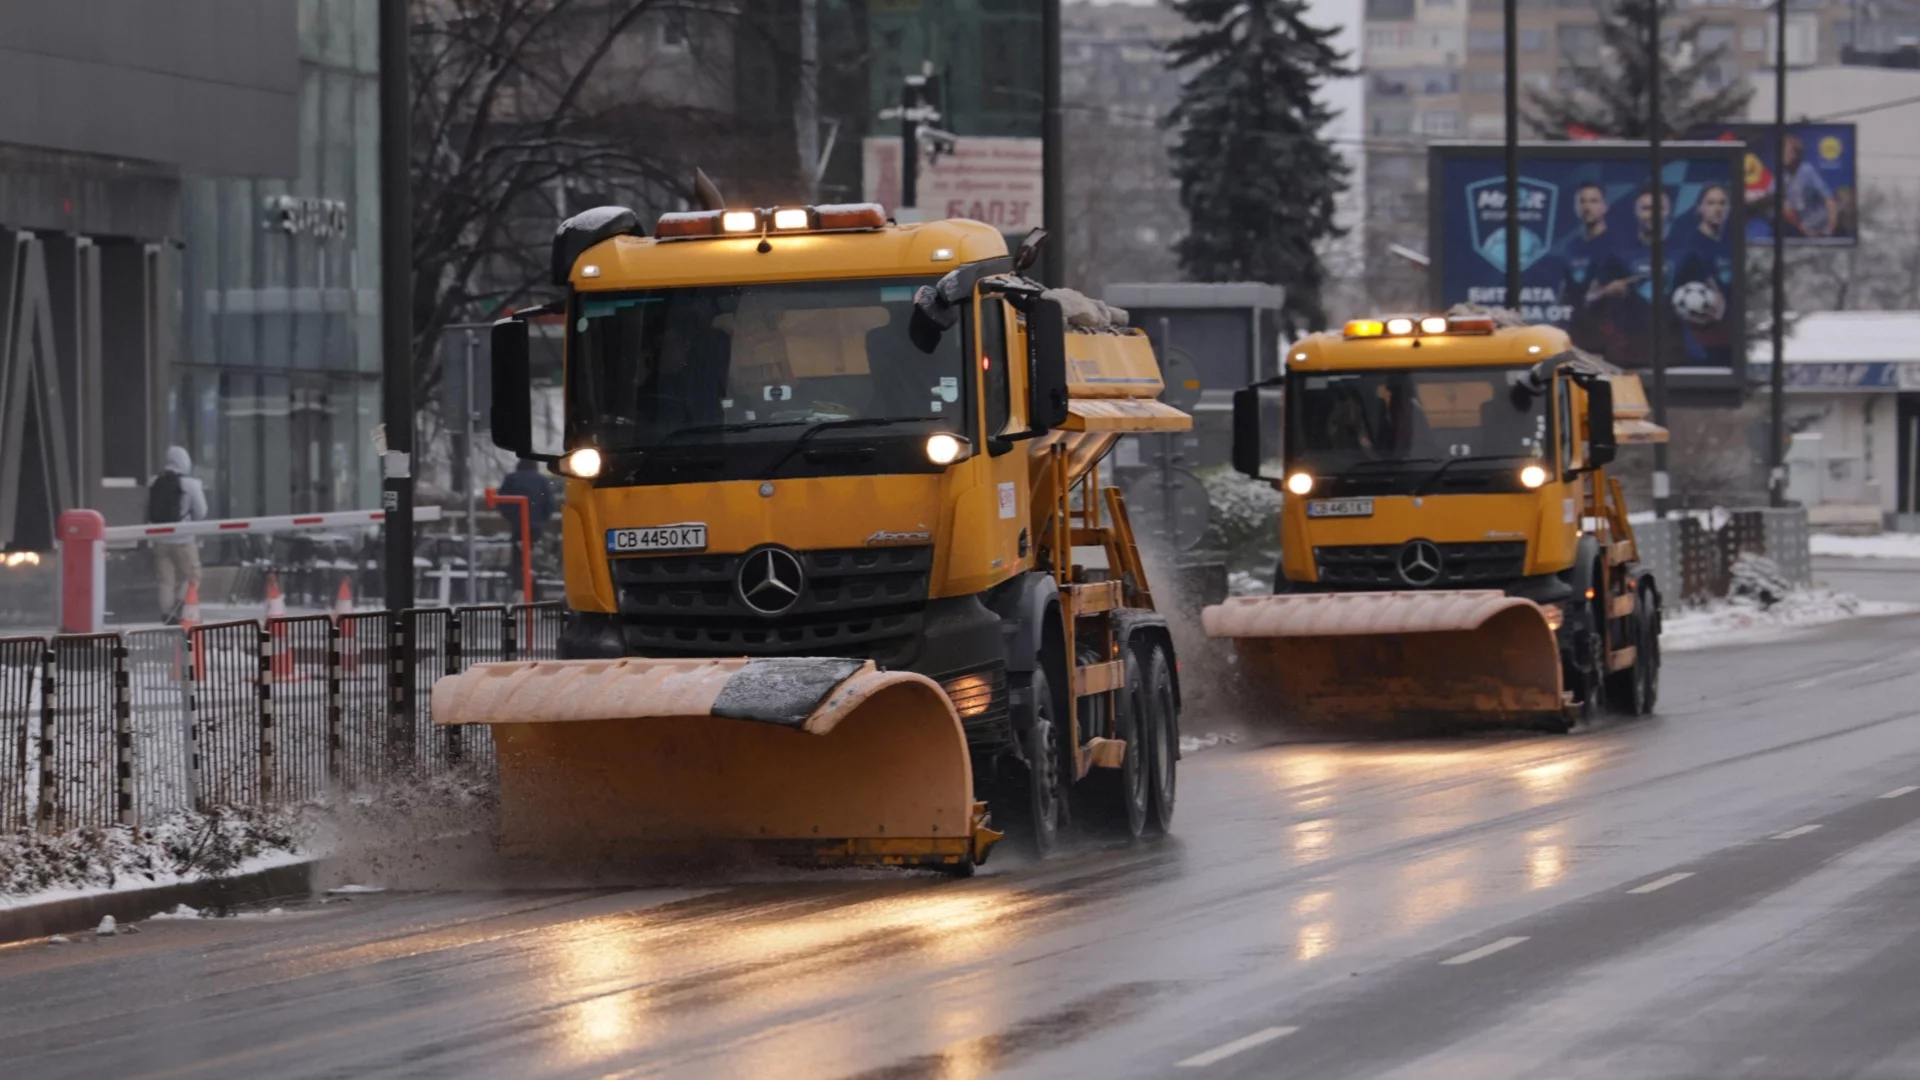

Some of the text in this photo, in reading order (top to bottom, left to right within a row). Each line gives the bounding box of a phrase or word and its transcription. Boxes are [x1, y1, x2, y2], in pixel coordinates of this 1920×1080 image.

[1468, 287, 1556, 303] БИТАТА
[641, 530, 678, 546] 4450
[681, 528, 702, 545] KT
